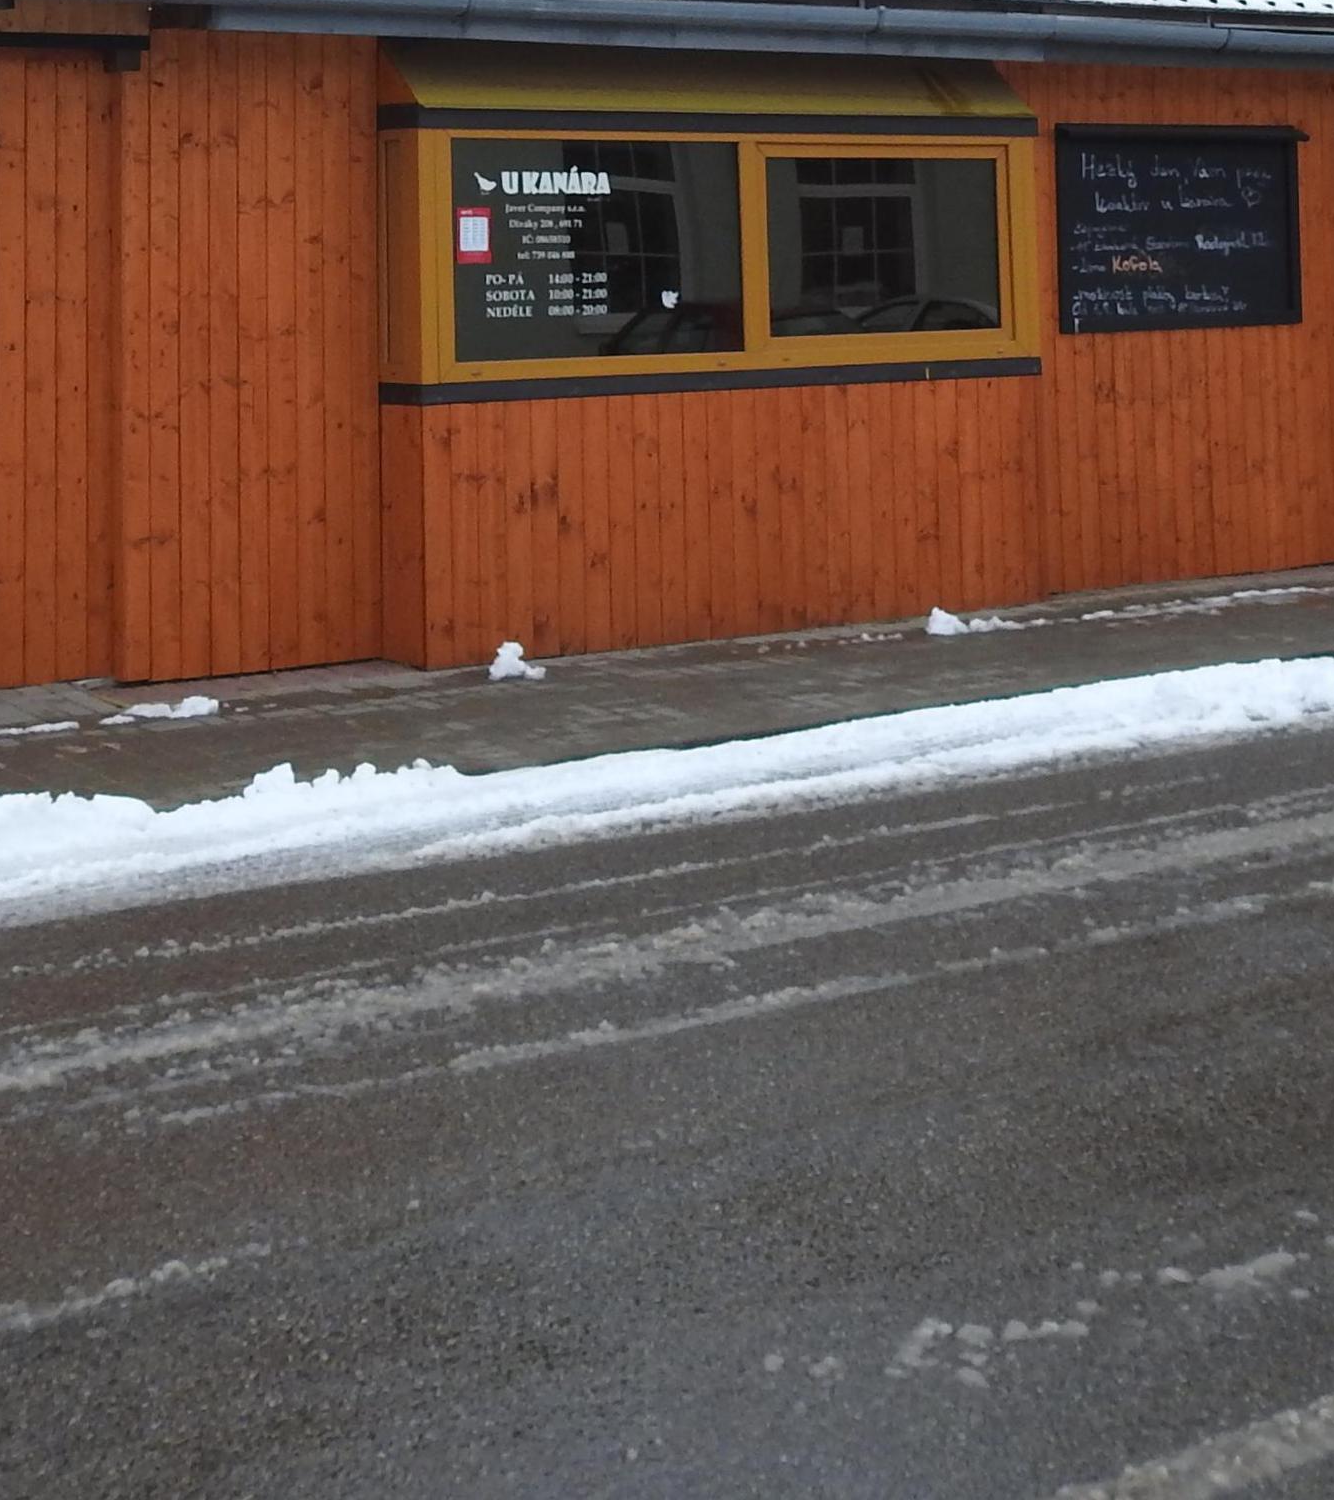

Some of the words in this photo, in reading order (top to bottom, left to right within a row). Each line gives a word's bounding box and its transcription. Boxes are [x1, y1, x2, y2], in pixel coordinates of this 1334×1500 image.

[501, 171, 519, 194] U
[522, 165, 611, 195] KANÁRA
[527, 203, 565, 215] Company
[1112, 255, 1163, 274] Kofola
[485, 289, 536, 302] SOBOTA
